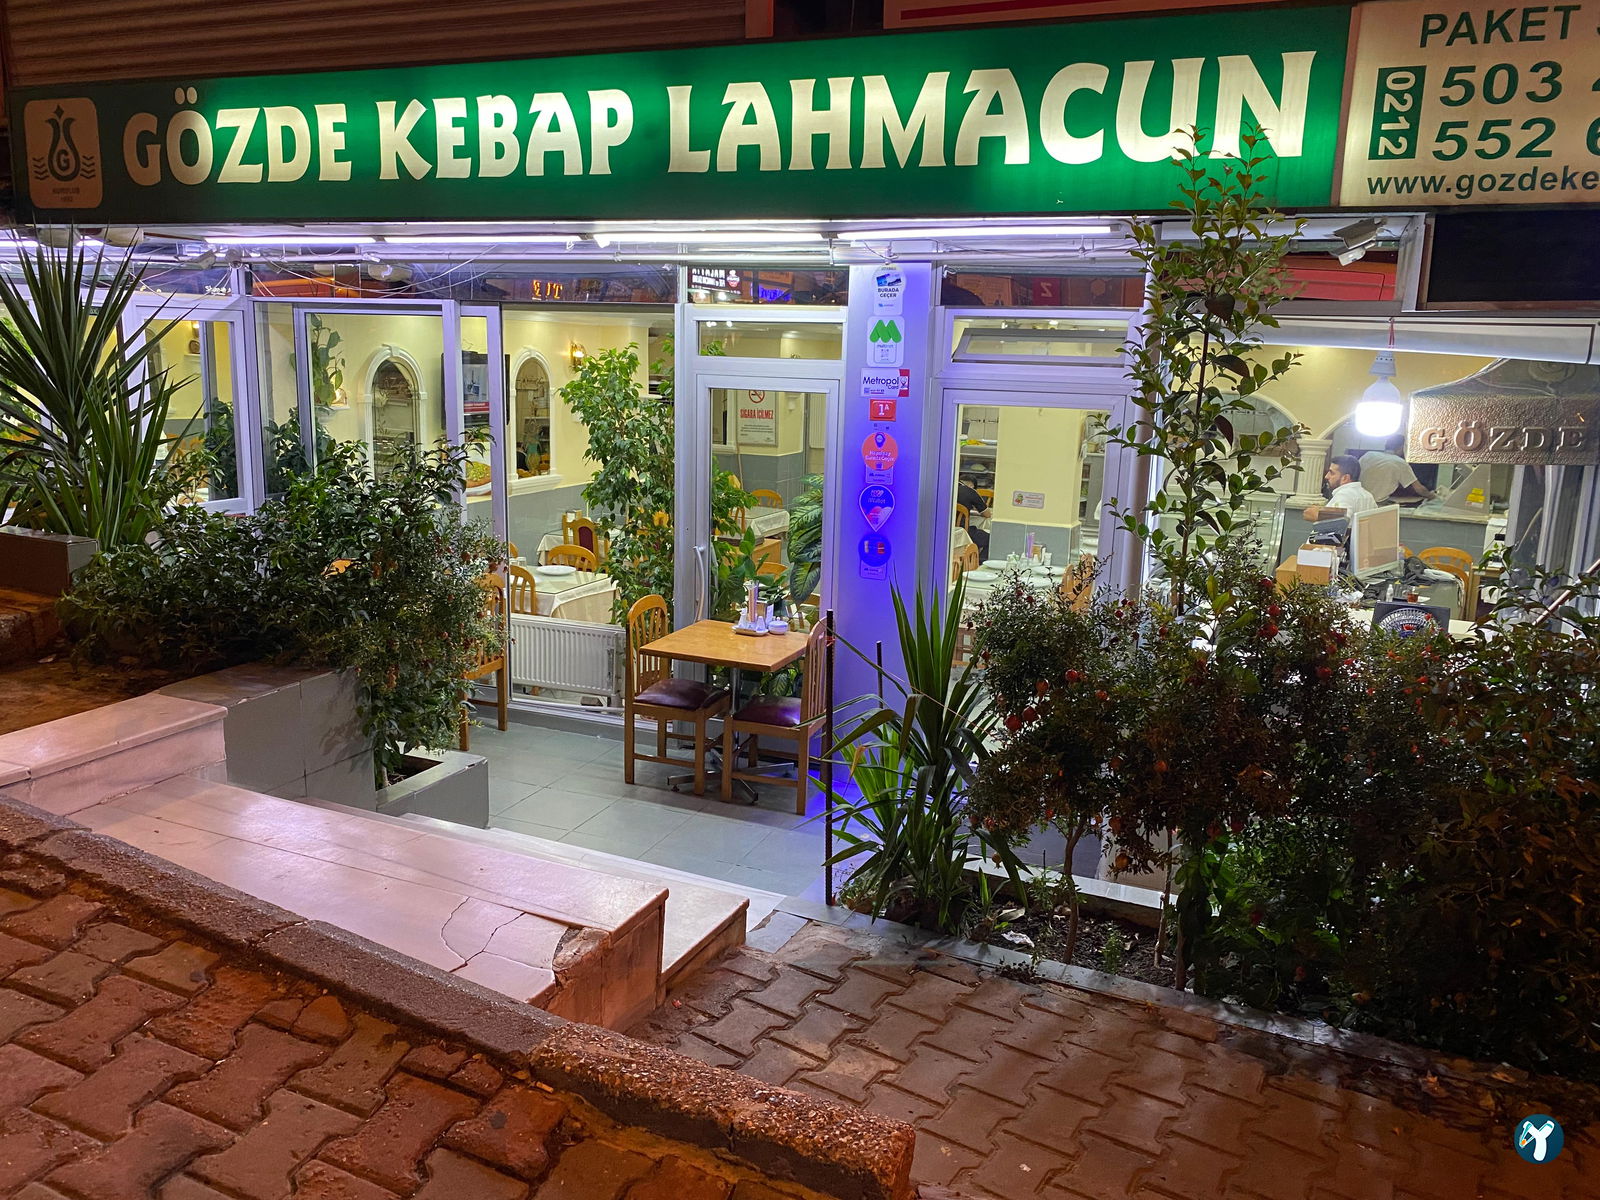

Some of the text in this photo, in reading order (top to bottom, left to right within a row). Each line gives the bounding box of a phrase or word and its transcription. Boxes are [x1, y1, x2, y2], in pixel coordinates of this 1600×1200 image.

[1420, 5, 1582, 48] PAKET
[1439, 60, 1563, 107] 503
[122, 50, 1318, 187] GÖZDE KEBAP LAHMACUN
[1377, 70, 1416, 157] 0212
[1432, 117, 1556, 161] 552
[1367, 165, 1600, 200] www.gozdeke
[862, 376, 899, 386] Metropol
[1419, 420, 1588, 452] GÖZDE
